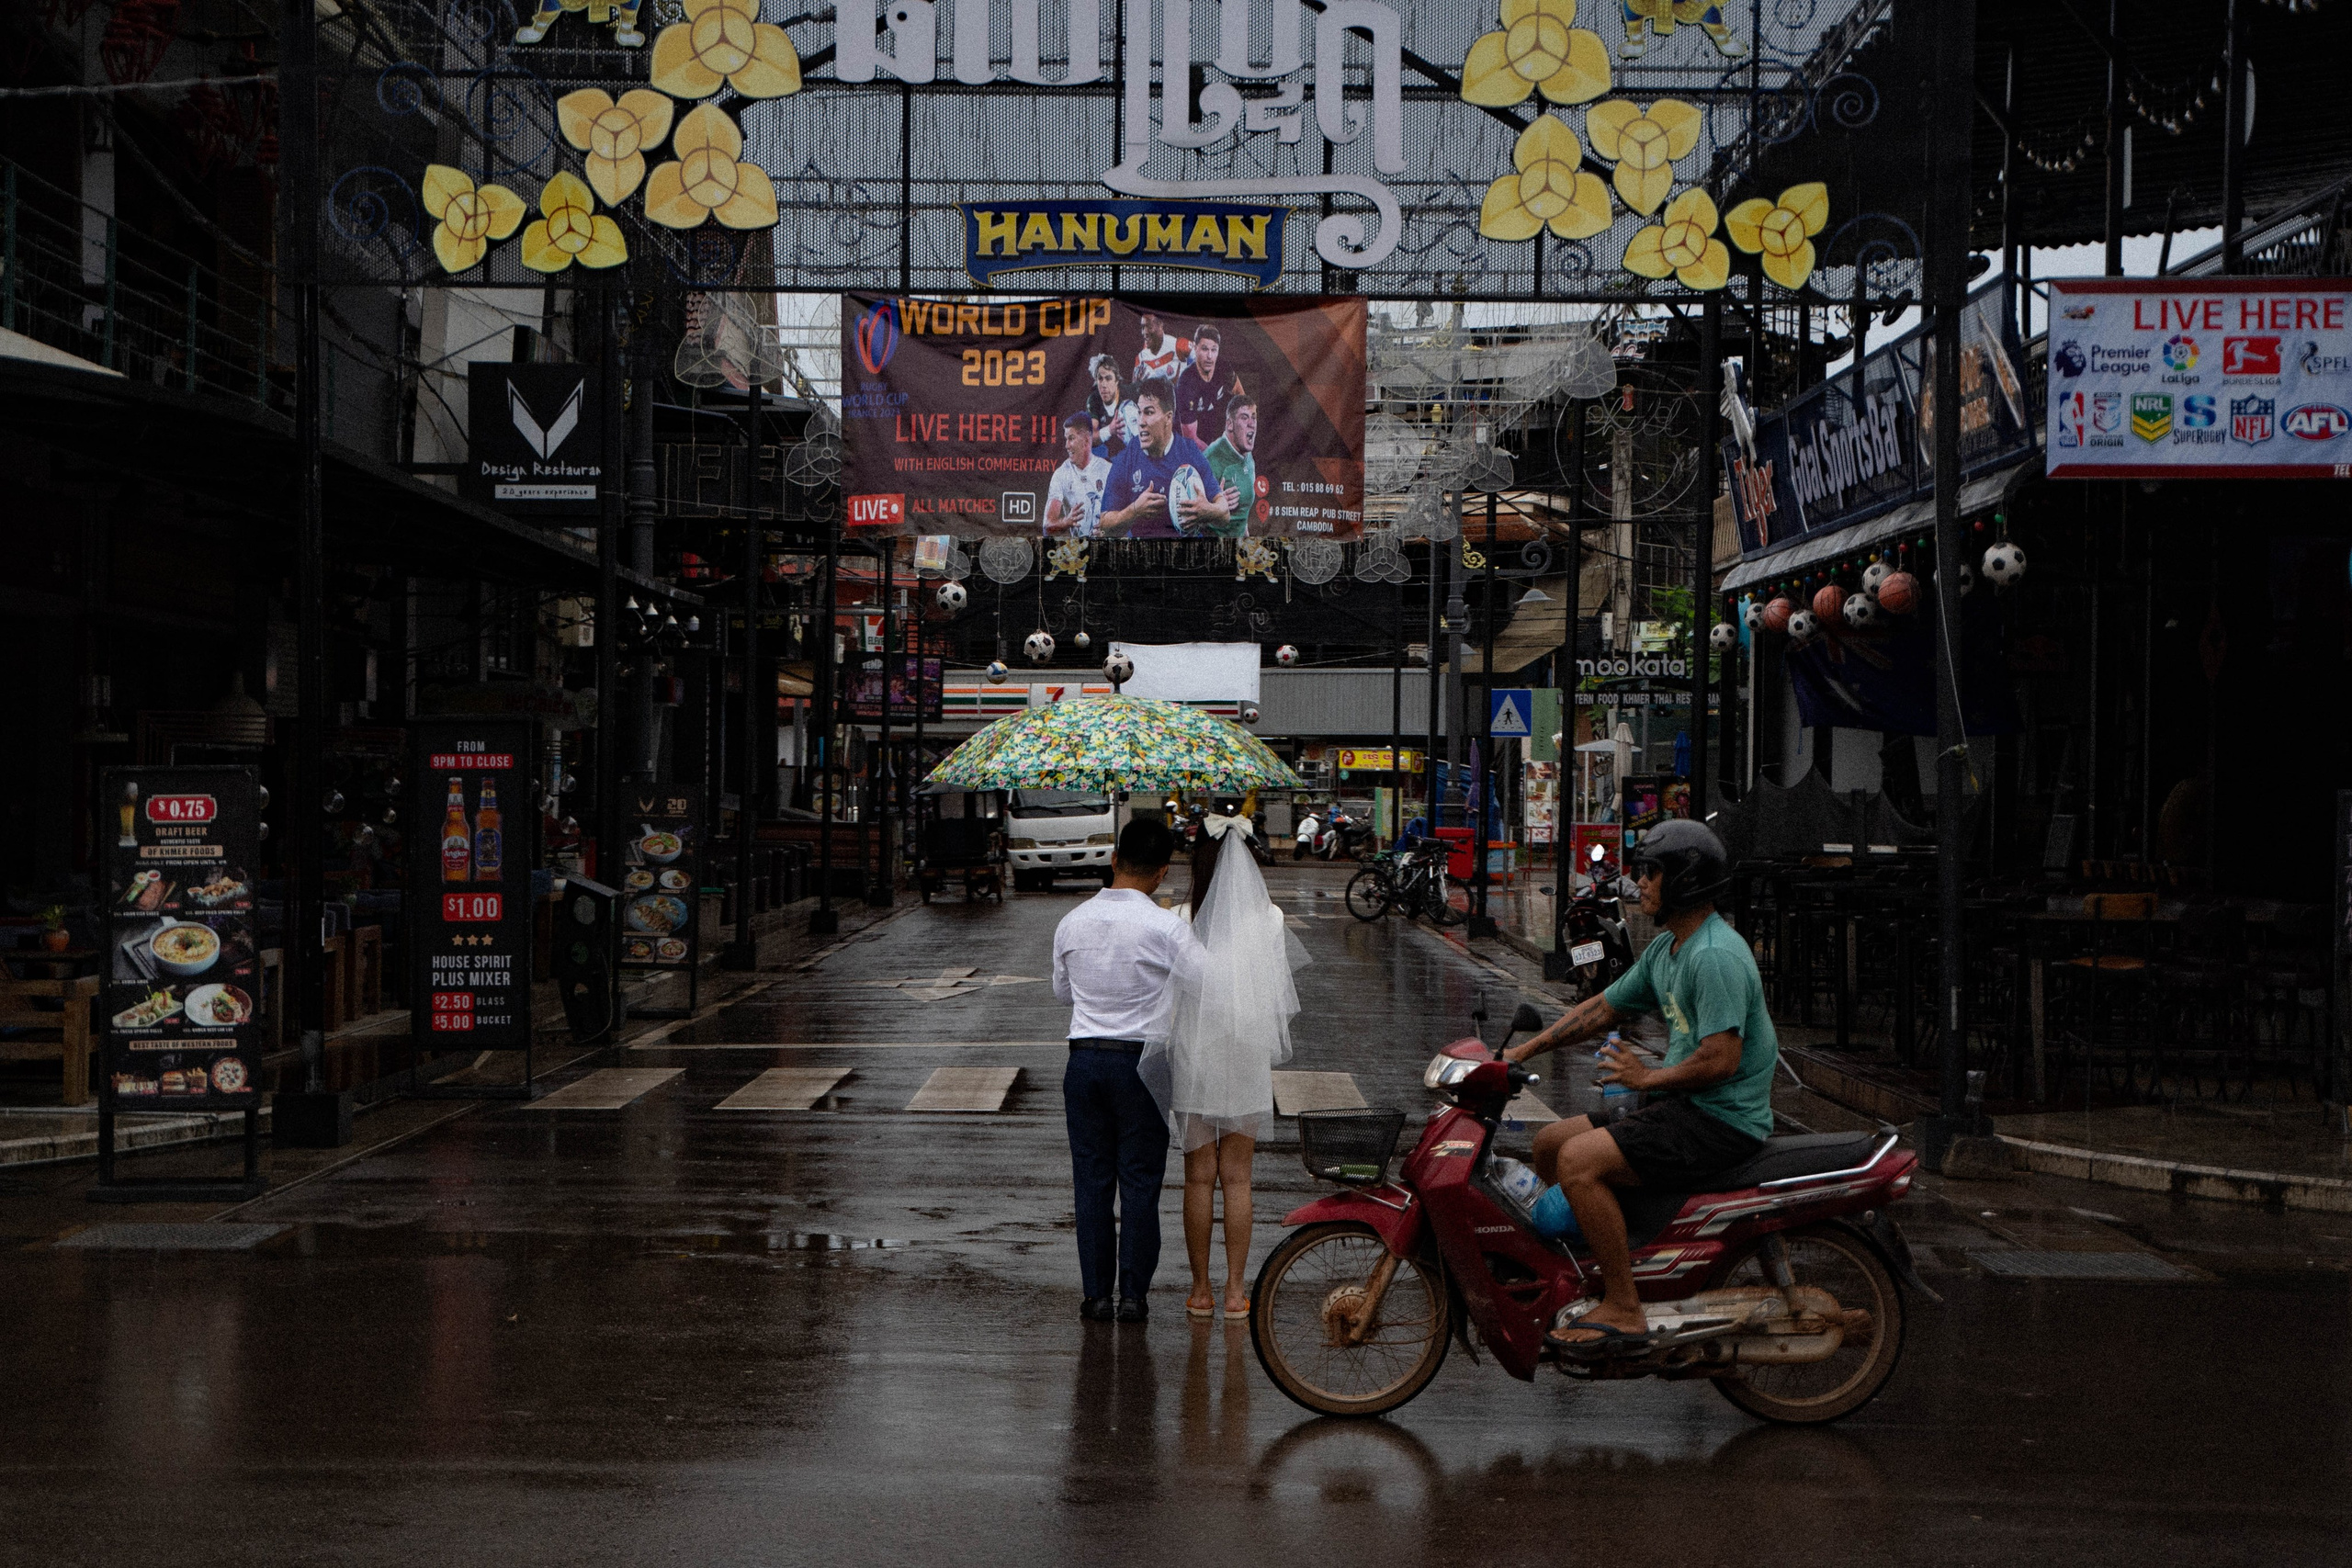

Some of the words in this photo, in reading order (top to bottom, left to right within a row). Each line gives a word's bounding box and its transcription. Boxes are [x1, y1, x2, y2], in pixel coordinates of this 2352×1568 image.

[972, 210, 1272, 261] HANUMAN
[898, 299, 1026, 336] WORLD
[1039, 298, 1111, 337] CUP
[2134, 299, 2222, 330] LIVE
[2240, 299, 2344, 330] HERE
[2091, 344, 2151, 359] Premier
[962, 349, 1046, 386] 2023
[2091, 360, 2150, 377] League
[2312, 356, 2349, 369] SPFL
[2162, 374, 2200, 385] LaLiga
[2222, 377, 2281, 386] BUNDESLIGA
[887, 392, 909, 406] CUP
[2135, 397, 2170, 412] NRL
[896, 413, 950, 443] LIVE
[958, 413, 1022, 443] HERE
[2233, 416, 2271, 441] NFL
[2286, 412, 2348, 433] AFL
[481, 461, 527, 481] Design
[533, 459, 602, 476] Restauran
[894, 457, 922, 471] WITH
[926, 457, 975, 471] ENGLISH
[978, 457, 1057, 472] COMMENTARY
[1282, 482, 1295, 492] TEL
[1300, 482, 1314, 492] 015
[1325, 483, 1334, 494] 69
[1335, 484, 1344, 494] 62
[854, 499, 888, 521] LIVE
[911, 499, 934, 513] ALL
[938, 498, 996, 514] MATCHES
[1009, 499, 1031, 514] HD
[1734, 459, 1778, 547] Tiger
[1281, 506, 1299, 517] SIEM
[1300, 507, 1319, 517] REAP
[1322, 508, 1337, 519] PUB
[1337, 509, 1362, 522] STREET
[1296, 520, 1334, 533] CAMBODIA
[1598, 693, 1619, 705] FOOD
[1623, 693, 1650, 705] KHMER
[457, 740, 485, 752] FROM
[433, 756, 455, 767] 9PM
[460, 756, 472, 767] TO
[477, 756, 510, 767] CLOSE
[155, 827, 183, 837] DRAFT
[185, 827, 208, 837] BEER
[190, 847, 215, 855] FOODS
[448, 897, 498, 918] $1.00
[432, 955, 469, 968] HOUSE
[474, 955, 512, 968] SPIRIT
[432, 972, 464, 986] PLUS
[469, 972, 511, 986] MIXER
[435, 996, 469, 1010] $2.50
[435, 1015, 469, 1029] $5.00
[476, 1015, 512, 1024] BUCKET
[1474, 1225, 1516, 1235] HONDA
